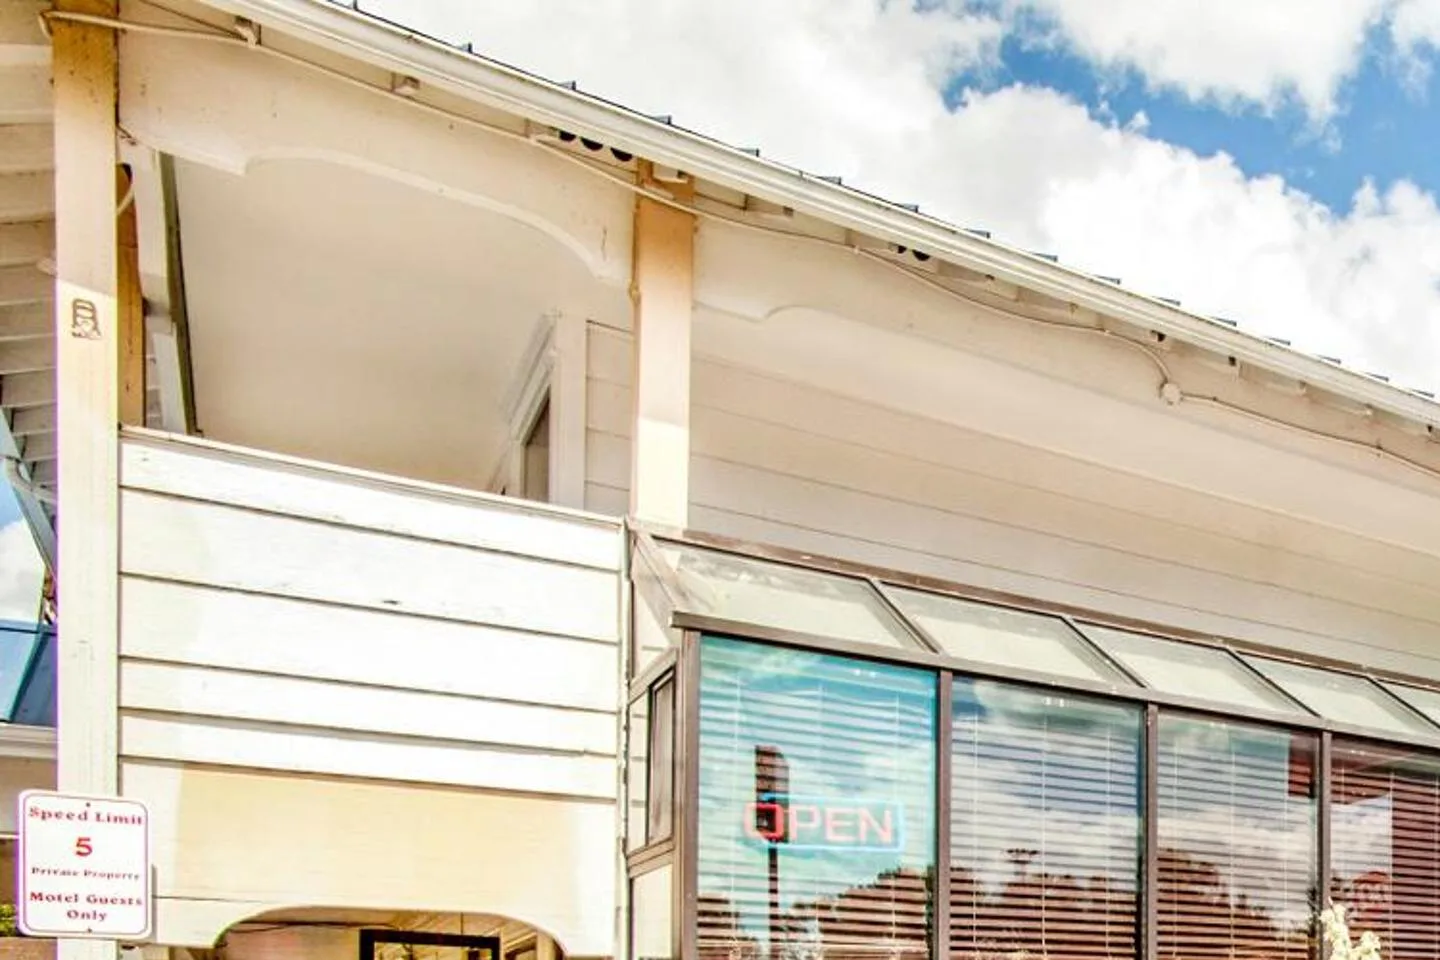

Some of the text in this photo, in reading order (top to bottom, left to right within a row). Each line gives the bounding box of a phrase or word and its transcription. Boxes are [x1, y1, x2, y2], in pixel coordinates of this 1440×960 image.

[29, 806, 143, 825] Speed Limit
[743, 802, 893, 844] OPEN
[75, 836, 93, 857] 5
[31, 866, 140, 881] Private Property
[30, 891, 143, 906] Motel Guests
[66, 909, 107, 922] Only
